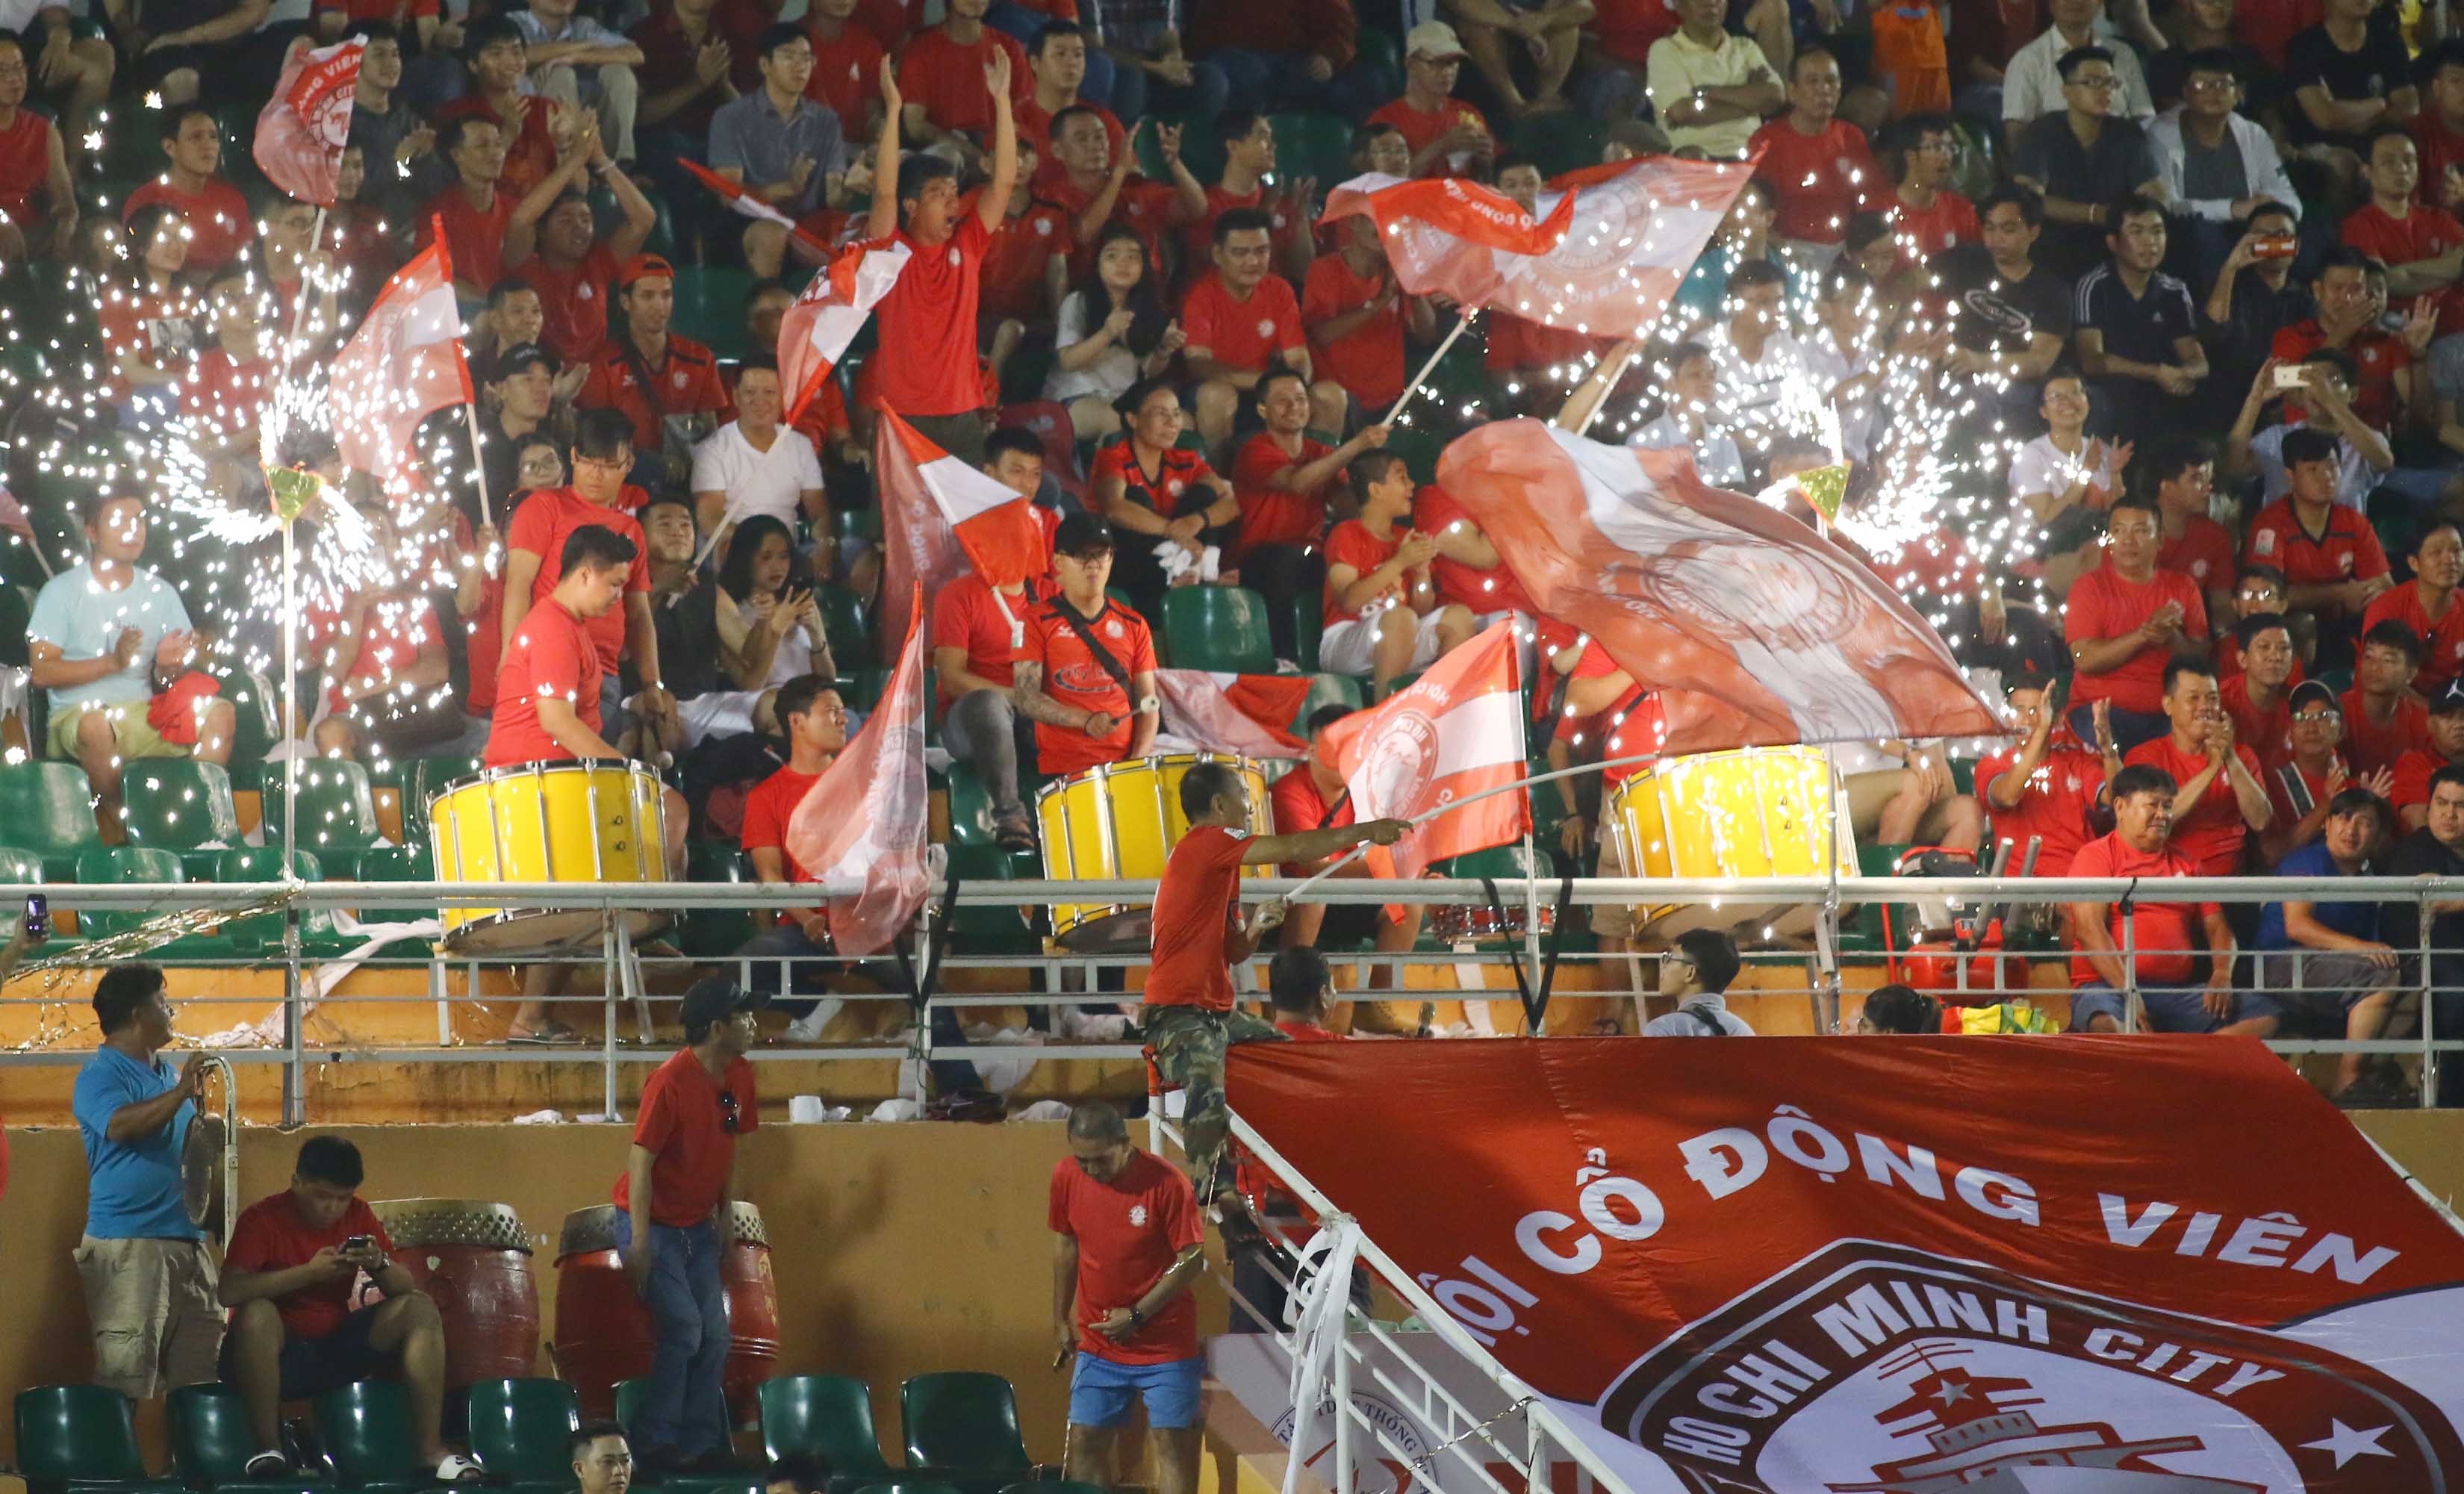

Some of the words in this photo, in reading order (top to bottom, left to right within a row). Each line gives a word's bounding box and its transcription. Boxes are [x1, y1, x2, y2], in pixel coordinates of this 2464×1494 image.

[1515, 1147, 1665, 1274] CỔ
[1677, 1104, 2041, 1227] ĐỘNG
[2097, 1192, 2401, 1285] VIÊN
[1811, 1280, 2050, 1359] MINH
[1696, 1339, 1832, 1419] CHI
[2082, 1328, 2287, 1398] CITY
[1663, 1416, 1751, 1466] HO
